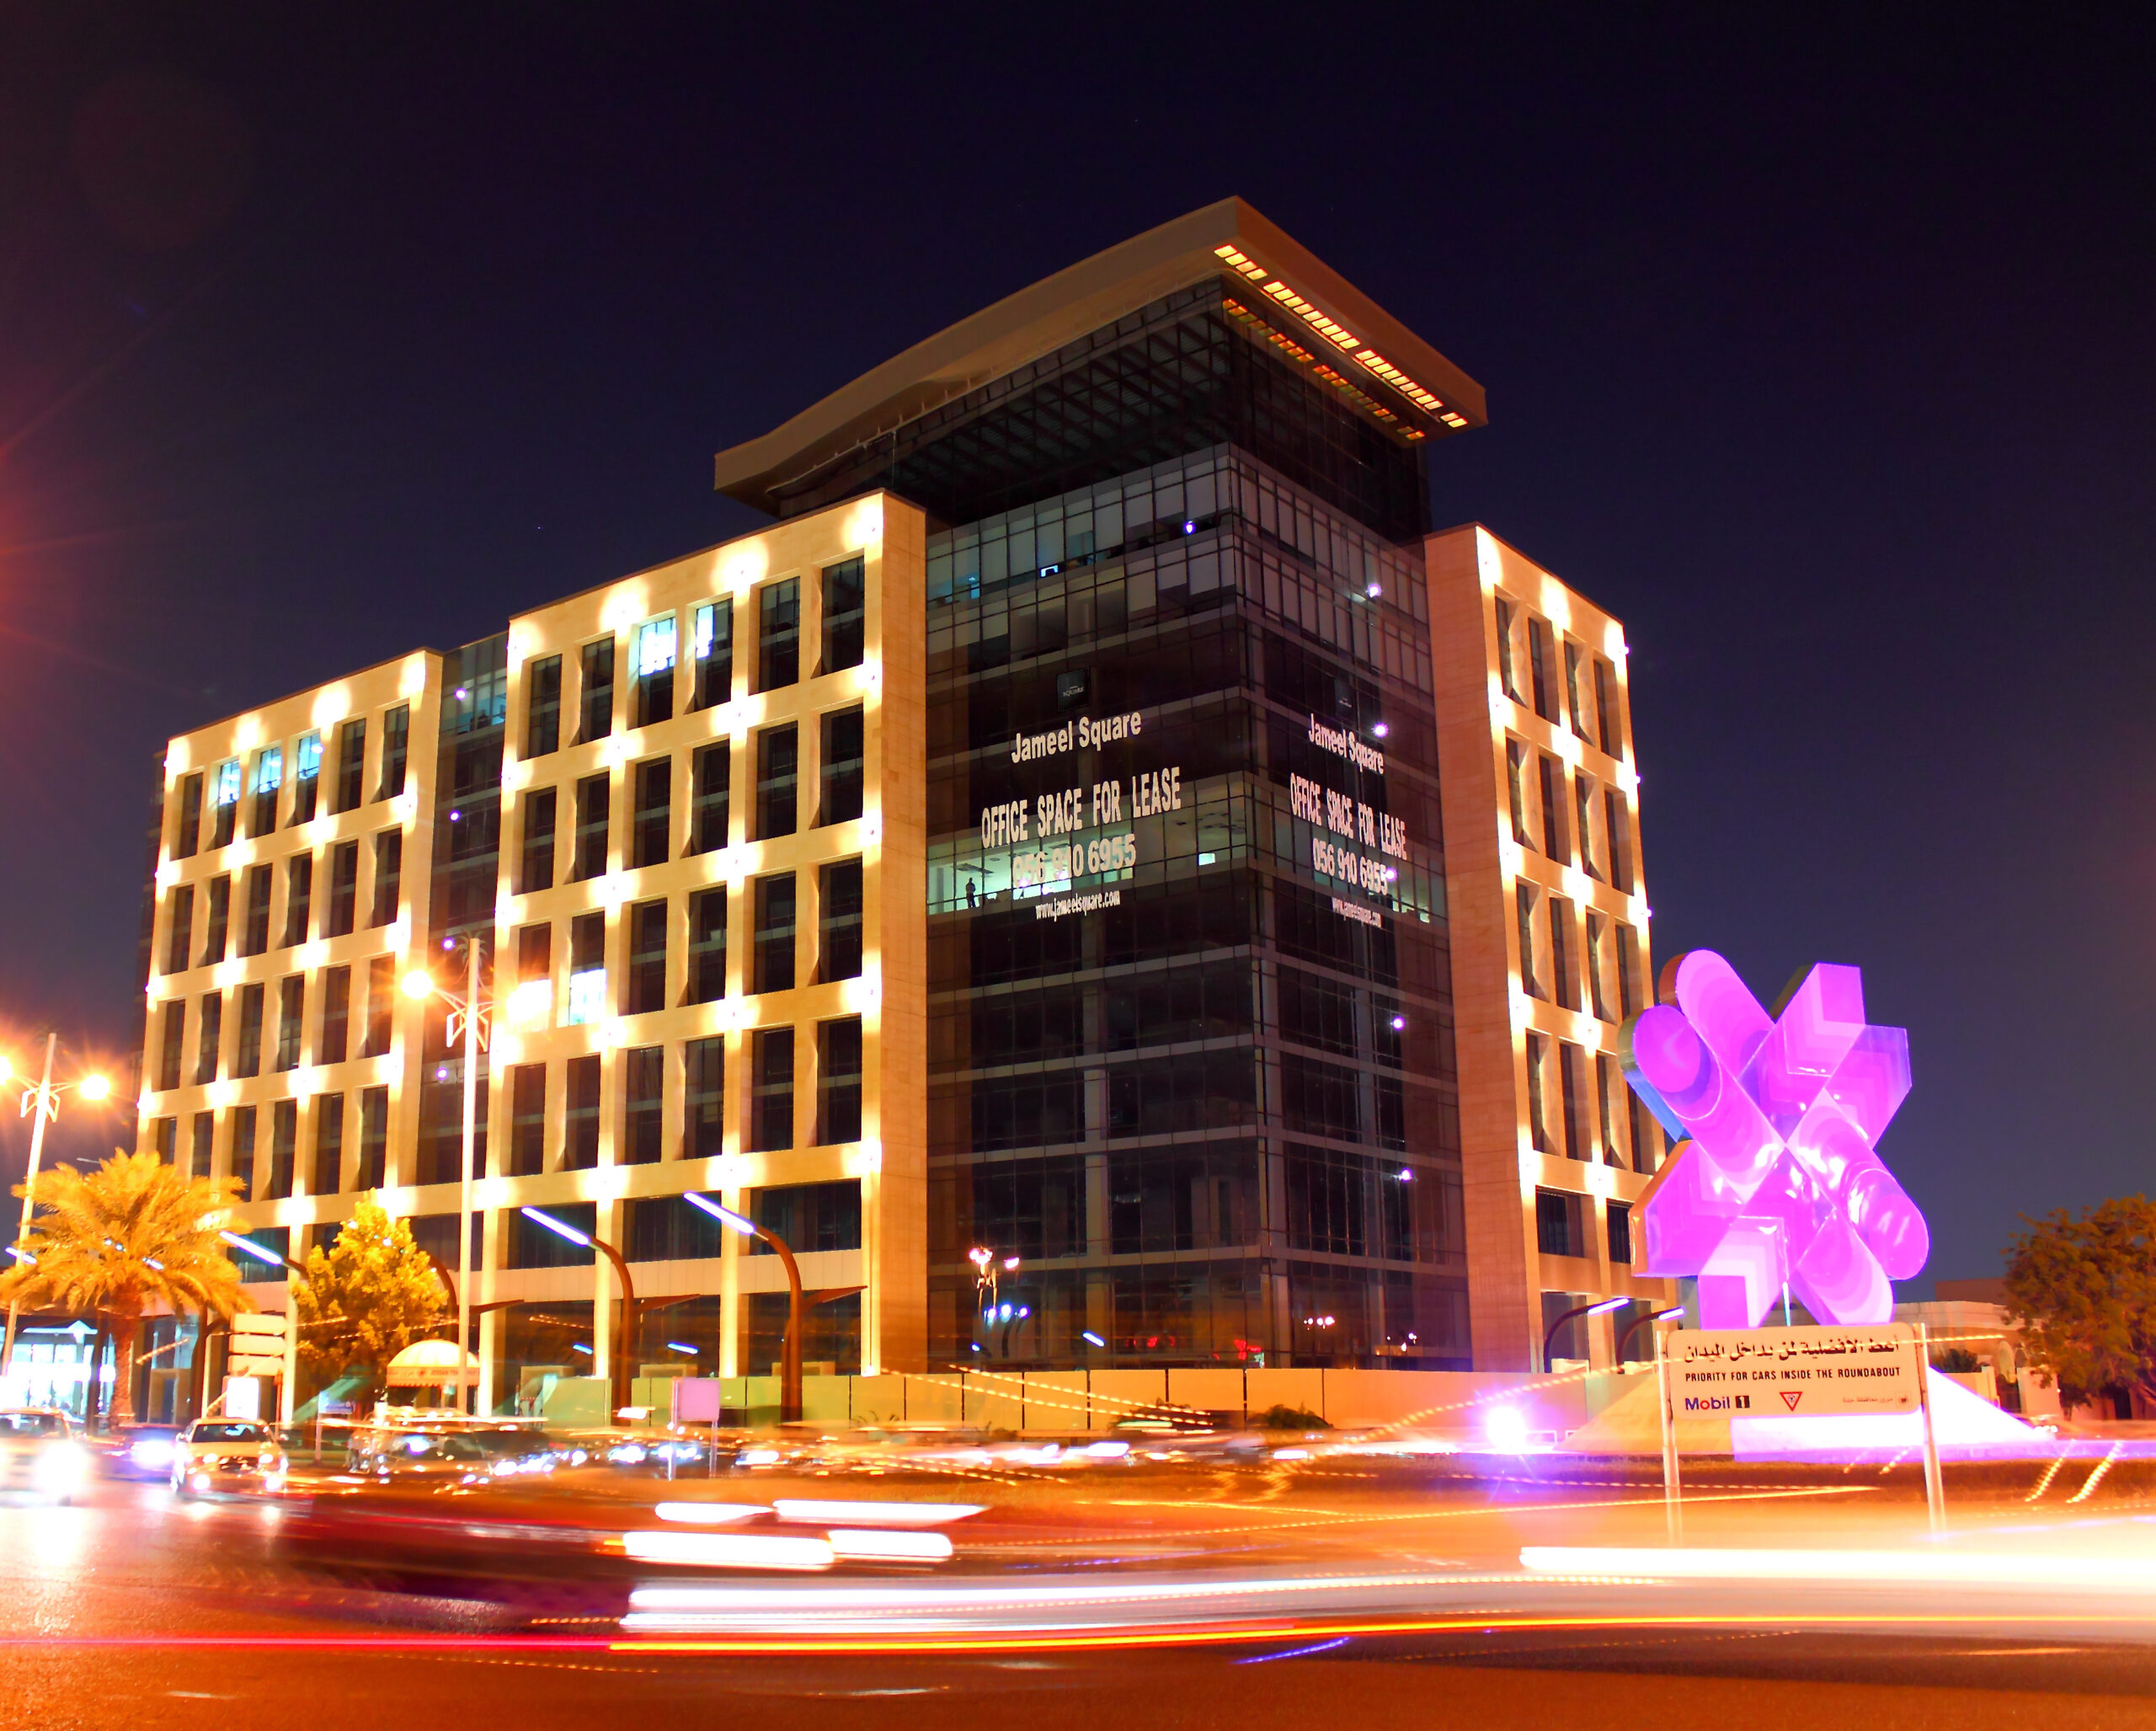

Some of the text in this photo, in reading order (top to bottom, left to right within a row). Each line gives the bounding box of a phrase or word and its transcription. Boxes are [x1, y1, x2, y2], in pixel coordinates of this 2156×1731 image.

[1011, 712, 1141, 763] Jameel Square
[1309, 713, 1385, 774] Jameel Square
[982, 767, 1182, 848] OFFICE SPACE FOR LEASE
[1290, 772, 1407, 861] OFFICE SPACE FOR LEASE
[1012, 834, 1136, 888] 056 910 6955
[1312, 838, 1389, 895] 056 910 6955
[1035, 890, 1120, 922] www.jameelsquare.com
[1869, 1334, 1898, 1352] أعط
[1685, 1367, 1901, 1381] PRIORITY FOR CARS INSIDE THE ROUNDABOUT
[1684, 1395, 1749, 1410] Mobil 1
